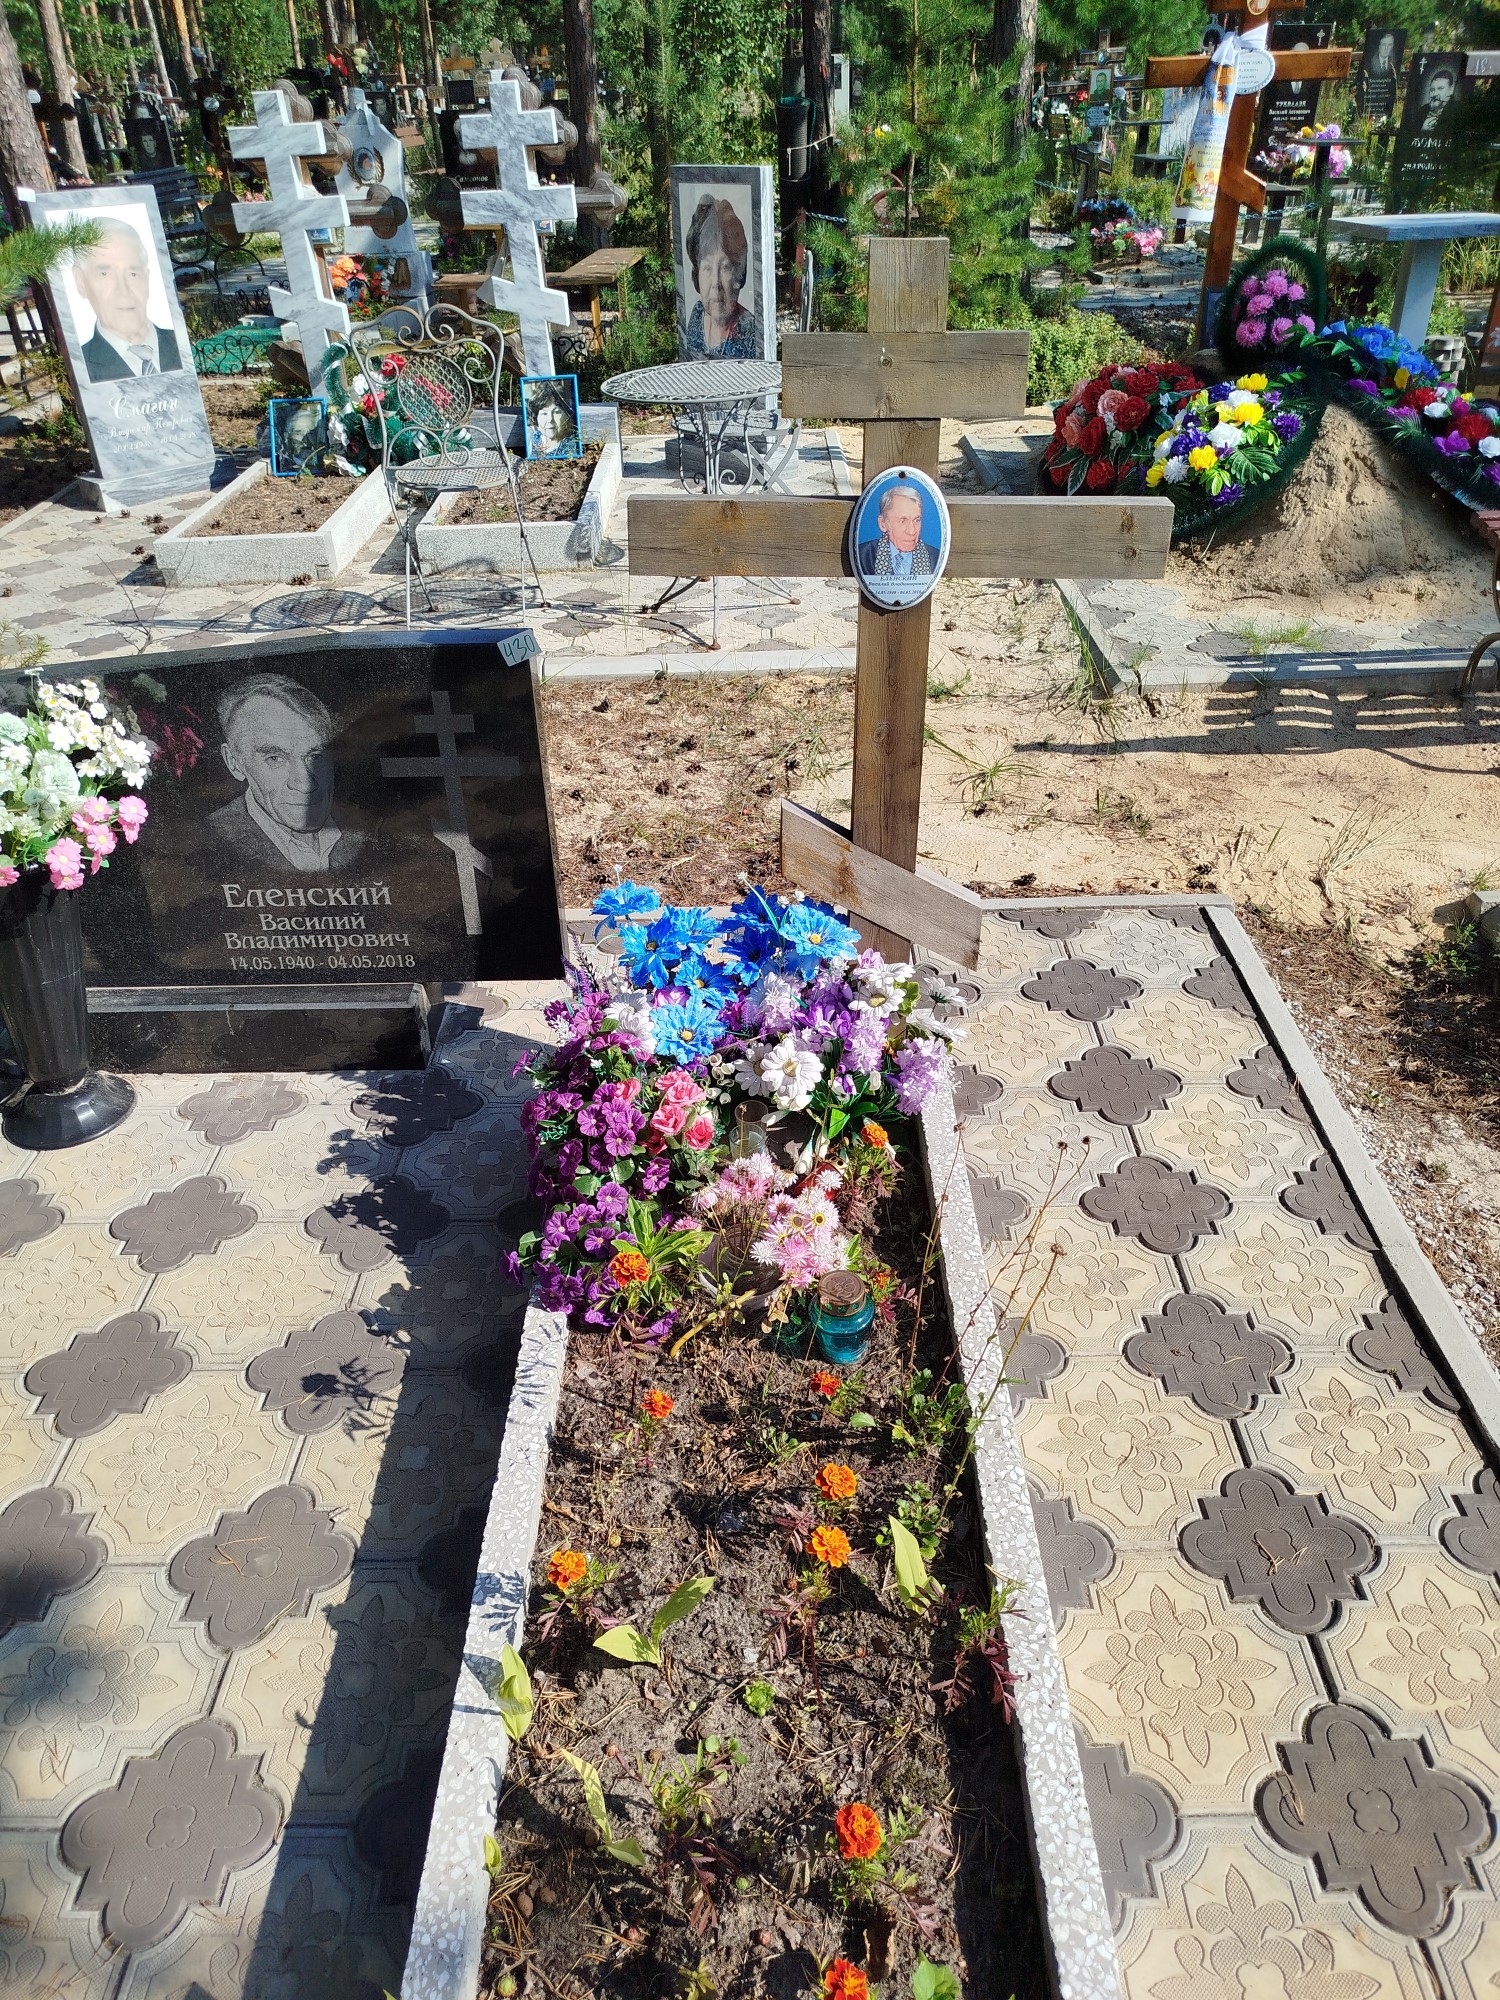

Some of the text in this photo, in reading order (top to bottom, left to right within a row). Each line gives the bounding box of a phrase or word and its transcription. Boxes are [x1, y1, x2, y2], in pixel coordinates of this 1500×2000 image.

[502, 634, 536, 663] 430
[221, 881, 393, 908] Еленский
[258, 912, 367, 931] Василий
[223, 932, 410, 952] Владимирович
[230, 956, 315, 970] 14.05.1940
[327, 954, 416, 969] 04.05.2018
